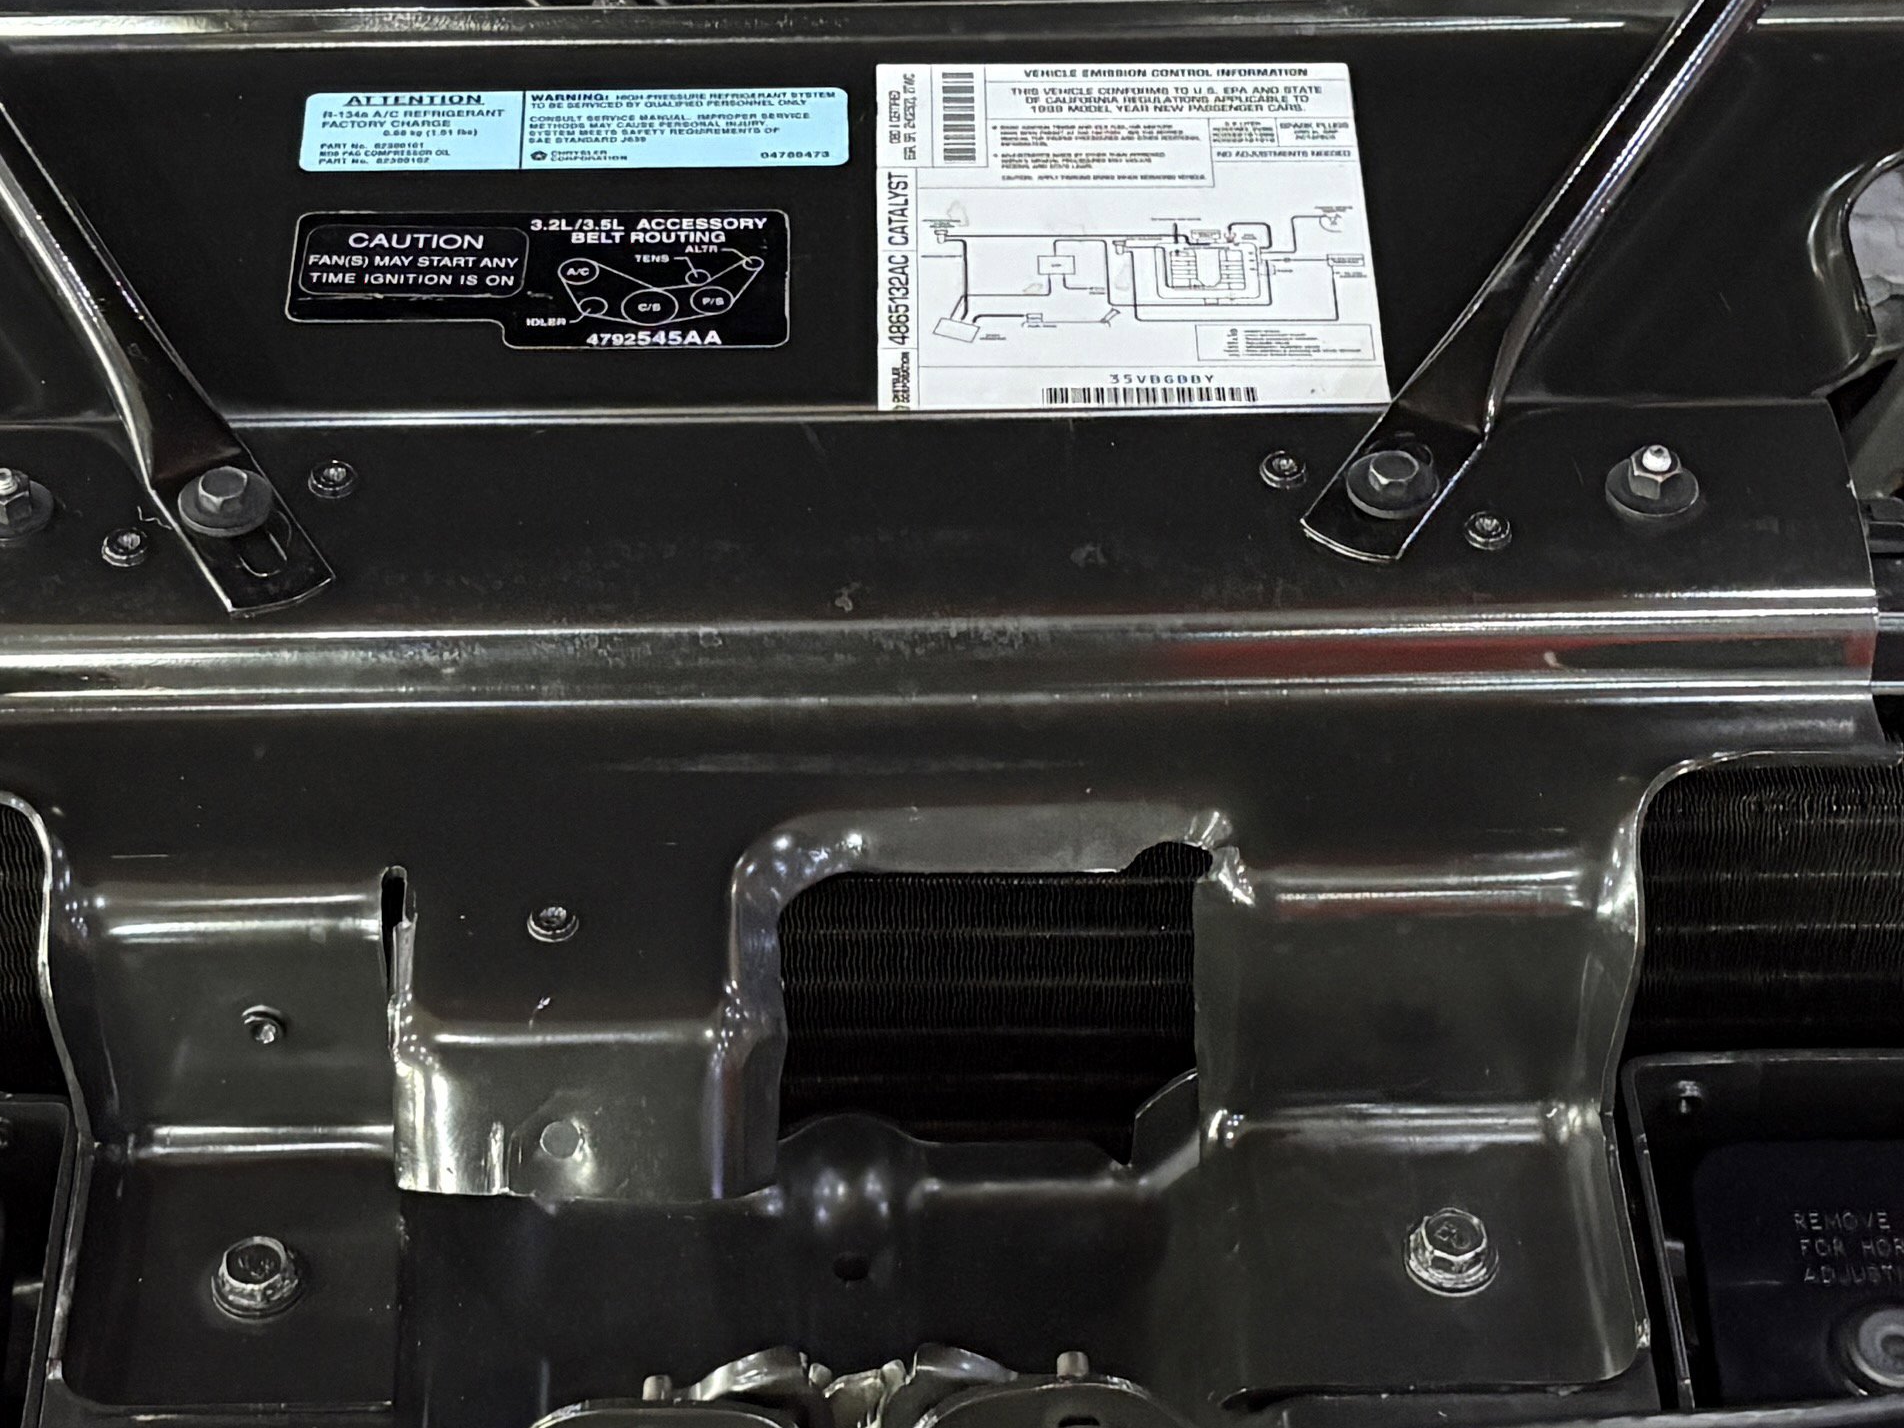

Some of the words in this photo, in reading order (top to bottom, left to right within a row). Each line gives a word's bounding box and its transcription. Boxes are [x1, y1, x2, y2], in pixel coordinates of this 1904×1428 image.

[1023, 69, 1078, 78] VEHICLE
[1081, 68, 1147, 78] EMISSION
[1150, 68, 1213, 78] CONTROL
[1216, 67, 1308, 77] INFORMATION
[1010, 87, 1039, 96] THIS
[1043, 87, 1094, 96] VEHICLE
[1097, 87, 1170, 95] CONFORMS
[1175, 86, 1189, 95] TO
[1222, 86, 1248, 95] EPA
[1251, 86, 1280, 95] AND
[1283, 85, 1323, 94] STATE
[344, 95, 483, 106] ATTENTION
[530, 93, 609, 102] WARNING!
[1024, 96, 1041, 104] OF
[1045, 96, 1119, 104] CALIFORNIA
[1122, 95, 1210, 104] REGULATIONS
[1213, 94, 1289, 103] APPLICABLE
[1294, 94, 1310, 103] TO
[1116, 104, 1150, 112] YEAR
[1153, 104, 1184, 112] NEW
[1188, 103, 1265, 112] PASSENGER
[372, 110, 399, 118] A/C
[403, 109, 505, 118] REFRIGERANT
[529, 115, 583, 123] CONSULT
[321, 120, 387, 129] FACTORY
[390, 119, 452, 128] CHARGE
[887, 172, 910, 247] CATALYST
[530, 218, 625, 232] 3.2L/3.5L
[636, 217, 768, 231] ACCESSORY
[348, 232, 485, 250] CAUTION
[570, 231, 626, 244] BELT
[630, 230, 727, 244] ROUTING
[684, 244, 719, 254] ALTR
[308, 254, 369, 269] FAN(S)
[373, 255, 413, 267] MAY
[416, 256, 477, 268] START
[479, 256, 520, 269] ANY
[634, 254, 670, 264] TENS
[565, 266, 591, 277] A/C
[309, 272, 356, 284] TIME
[363, 273, 453, 285] IGNITION
[459, 274, 478, 286] IS
[484, 275, 515, 287] ON
[887, 254, 910, 346] 4865132AC
[526, 317, 567, 327] IDLER
[585, 329, 723, 347] 4792545AA
[1794, 1210, 1891, 1230] REMOVE
[1799, 1238, 1847, 1256] FOR
